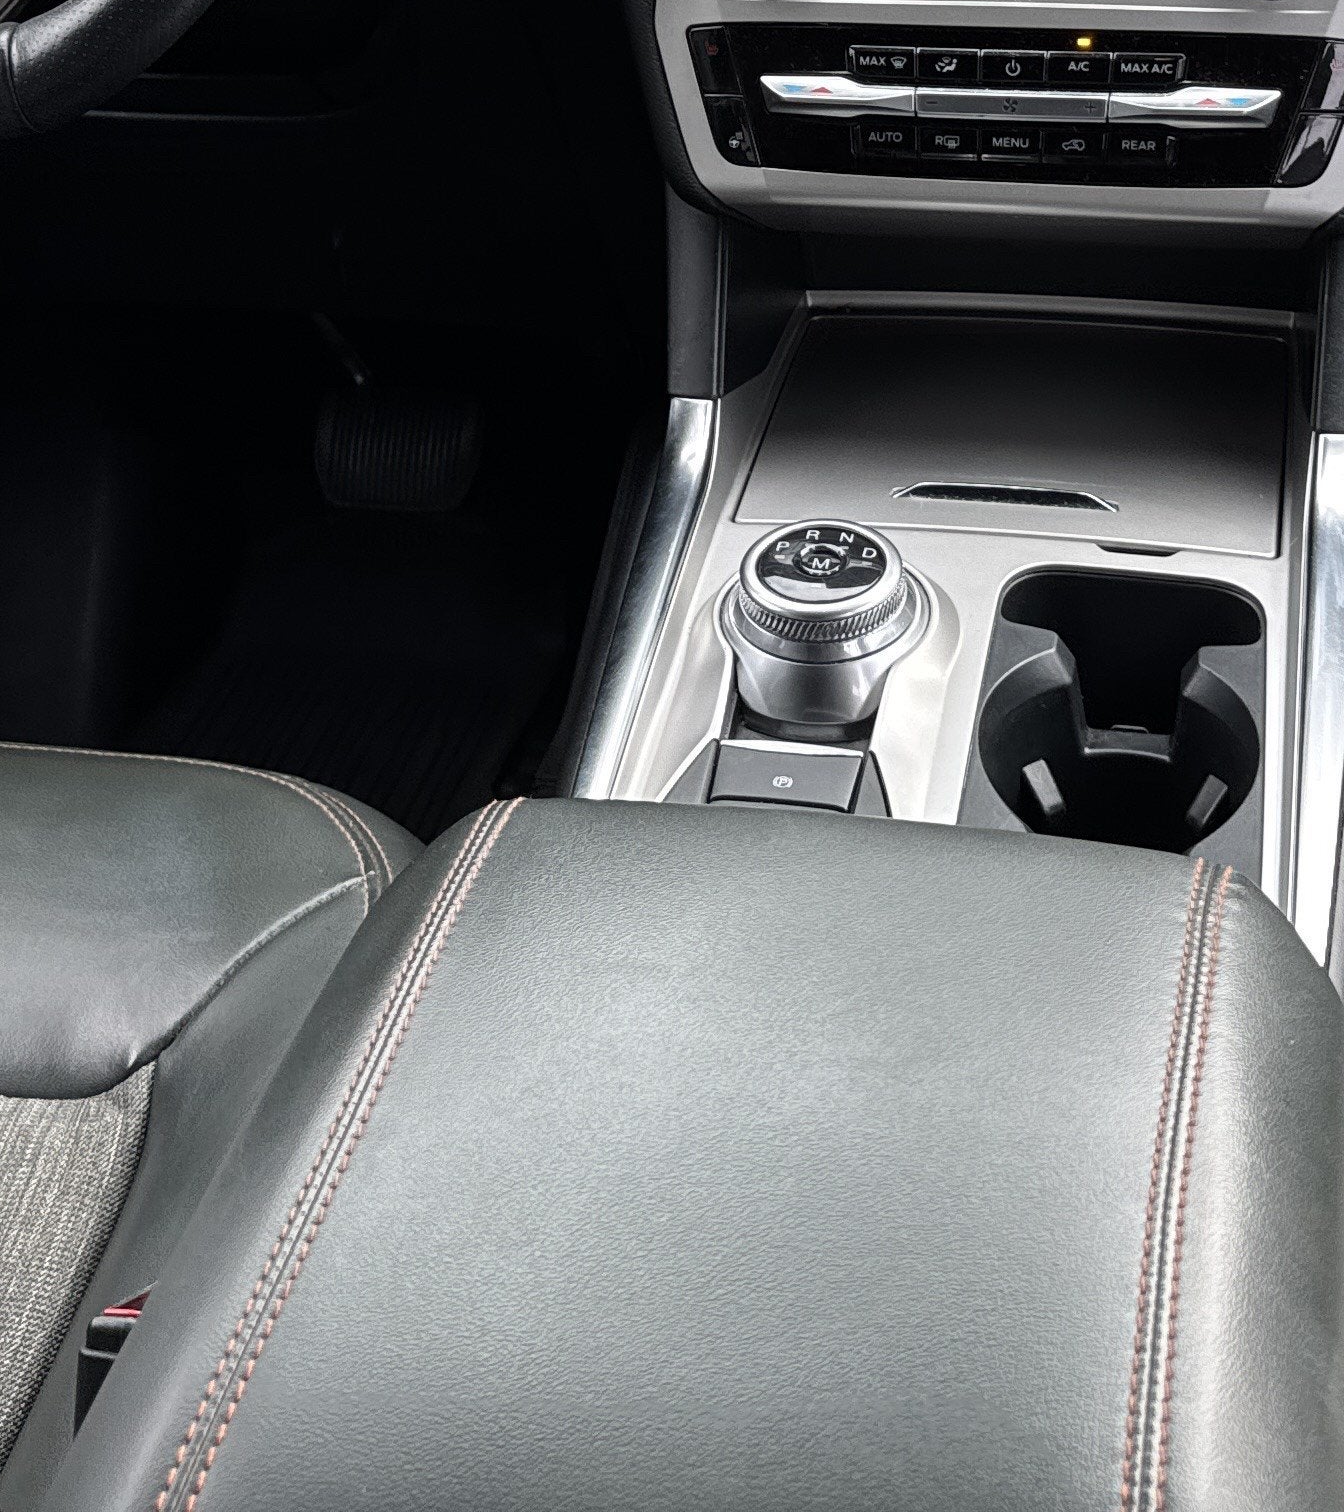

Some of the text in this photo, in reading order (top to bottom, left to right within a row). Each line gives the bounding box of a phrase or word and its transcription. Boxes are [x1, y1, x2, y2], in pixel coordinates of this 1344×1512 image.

[859, 55, 886, 67] MAX
[1068, 61, 1090, 73] A/C
[1120, 62, 1173, 75] MAX A/C
[868, 131, 903, 143] AUTO
[992, 137, 1029, 149] MENU
[1121, 139, 1155, 151] REAR
[806, 529, 821, 541] R
[839, 532, 854, 543] N
[776, 541, 790, 551] P
[861, 547, 877, 558] D
[811, 558, 830, 569] M
